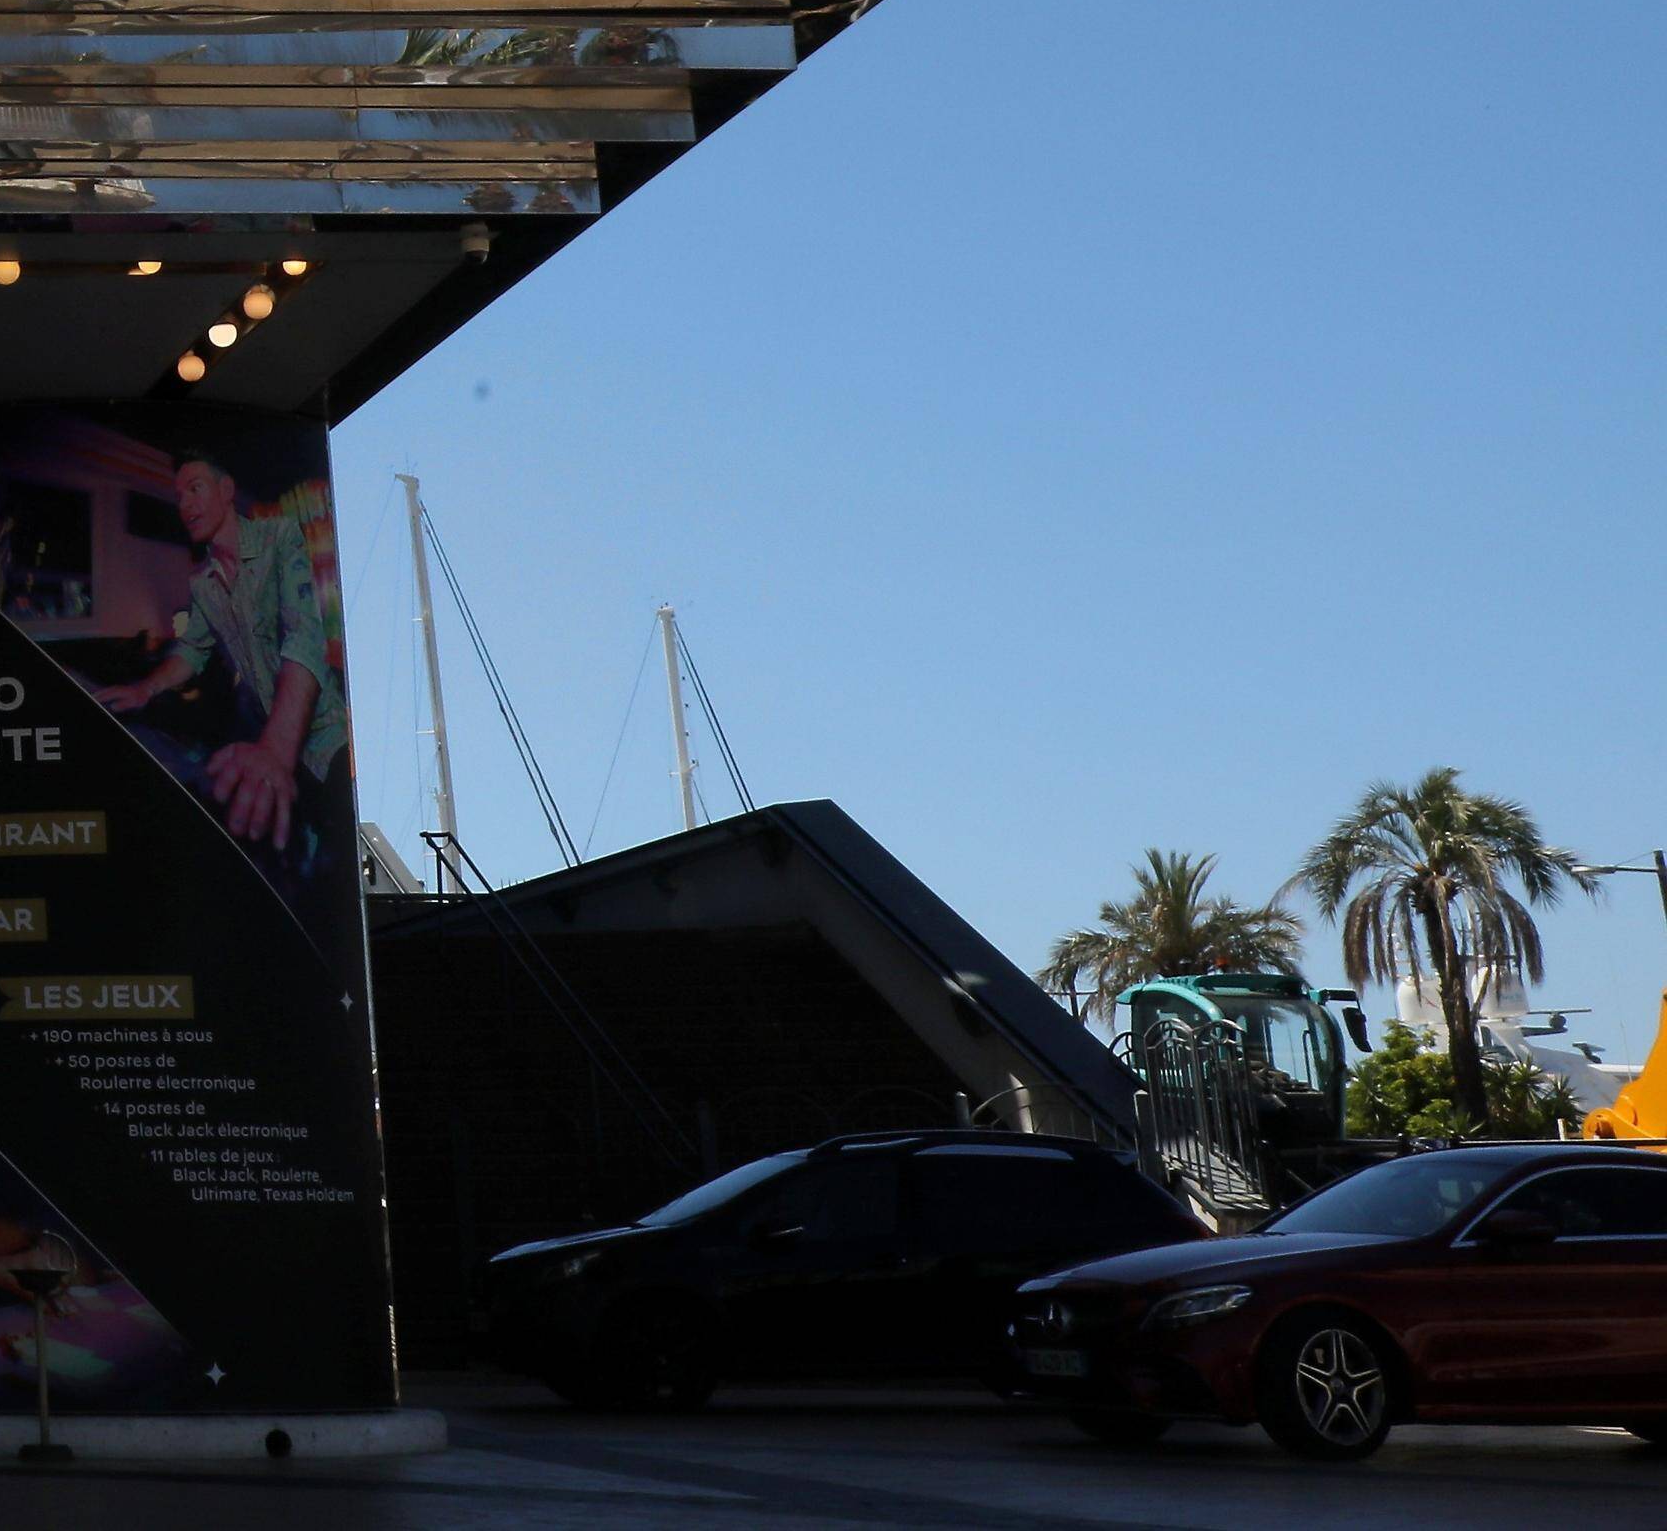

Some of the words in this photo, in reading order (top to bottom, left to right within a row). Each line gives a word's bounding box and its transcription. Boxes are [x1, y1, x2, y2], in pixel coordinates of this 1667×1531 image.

[23, 985, 84, 1009] LES
[92, 984, 182, 1010] JEUX
[42, 1030, 73, 1043] 190
[76, 1028, 158, 1044] machines
[162, 1028, 171, 1043] à
[175, 1031, 214, 1044] sous
[67, 1055, 91, 1068] 50
[94, 1055, 152, 1071] postes
[155, 1053, 177, 1068] de
[79, 1074, 152, 1090] Roulette
[155, 1073, 258, 1093] électronique
[103, 1102, 120, 1115] 14
[125, 1102, 182, 1119] postes
[184, 1100, 207, 1115] de
[127, 1123, 173, 1138] Black
[177, 1123, 214, 1138] Jack
[217, 1122, 309, 1141] électronique
[150, 1150, 165, 1163] 11
[168, 1148, 217, 1163] tables
[219, 1148, 240, 1163] de
[242, 1149, 275, 1167] jeux
[172, 1168, 217, 1182] Black
[219, 1168, 259, 1184] Jack,
[261, 1168, 324, 1185] Roulette,
[191, 1187, 261, 1204] Ultimate,
[265, 1188, 304, 1202] Texas
